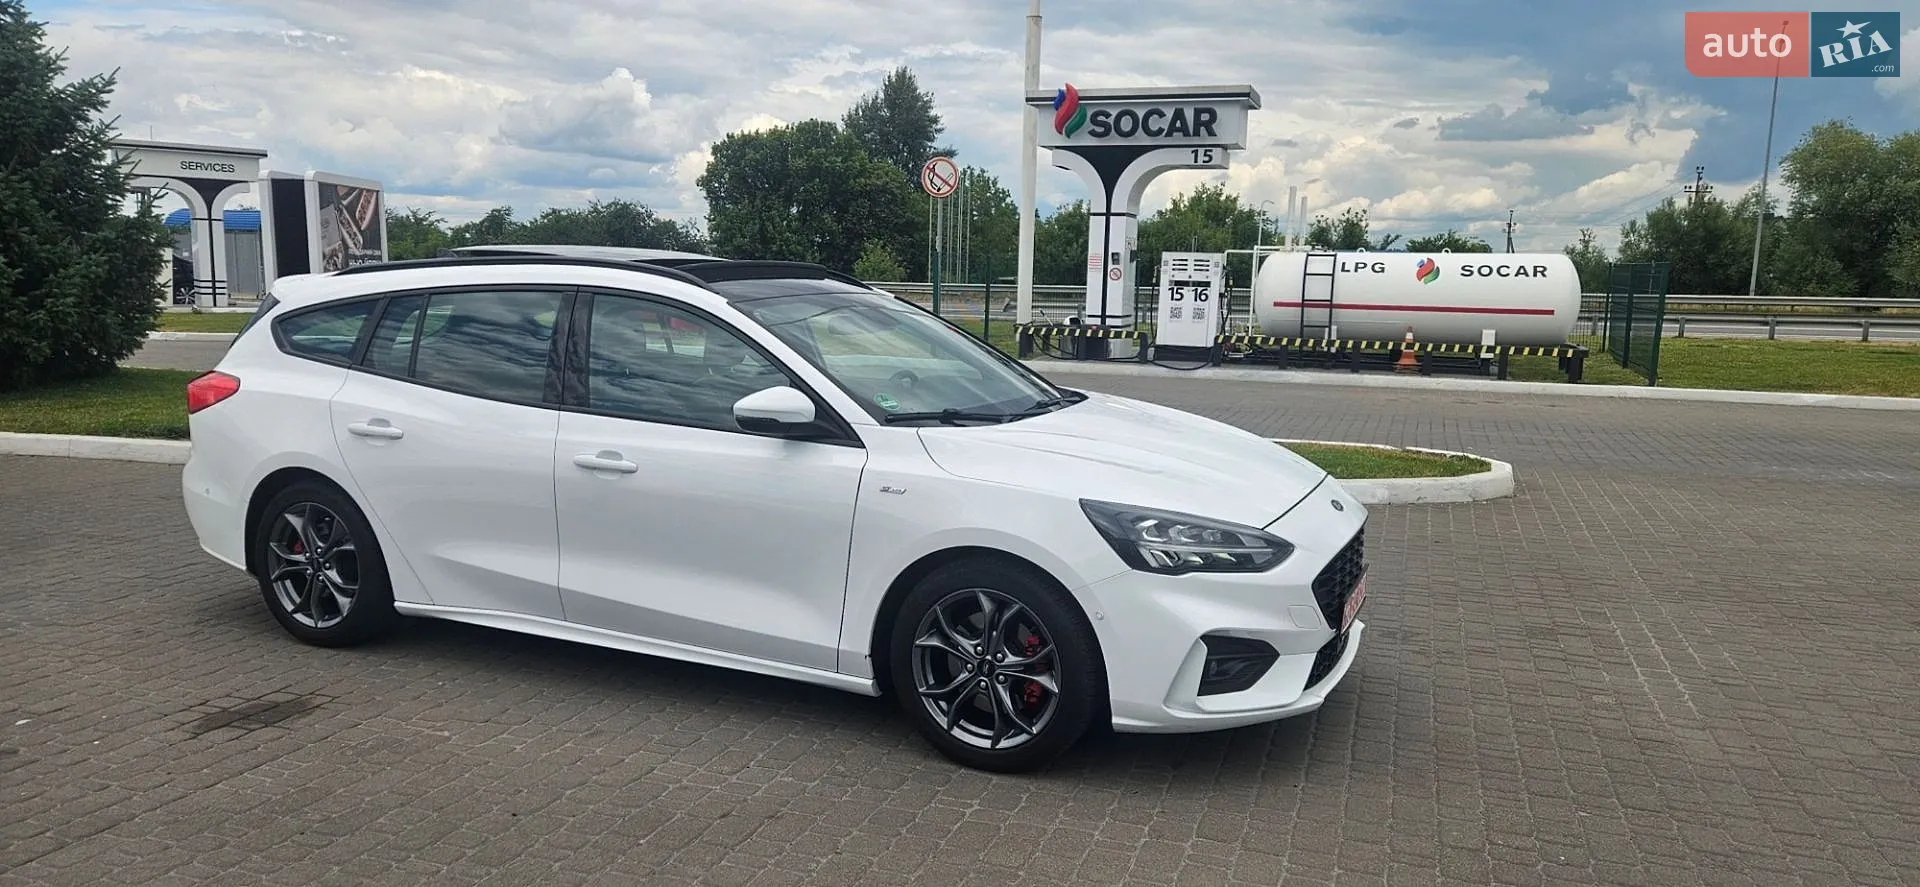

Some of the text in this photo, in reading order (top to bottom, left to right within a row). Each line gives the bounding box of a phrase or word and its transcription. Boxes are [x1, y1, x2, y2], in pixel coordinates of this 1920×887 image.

[1088, 107, 1218, 138] SOCAR
[1191, 149, 1213, 164] 15
[180, 160, 235, 173] SERVICES
[1340, 261, 1548, 278] LPG SOCAR
[1168, 286, 1184, 302] 15
[1191, 287, 1209, 302] 16
